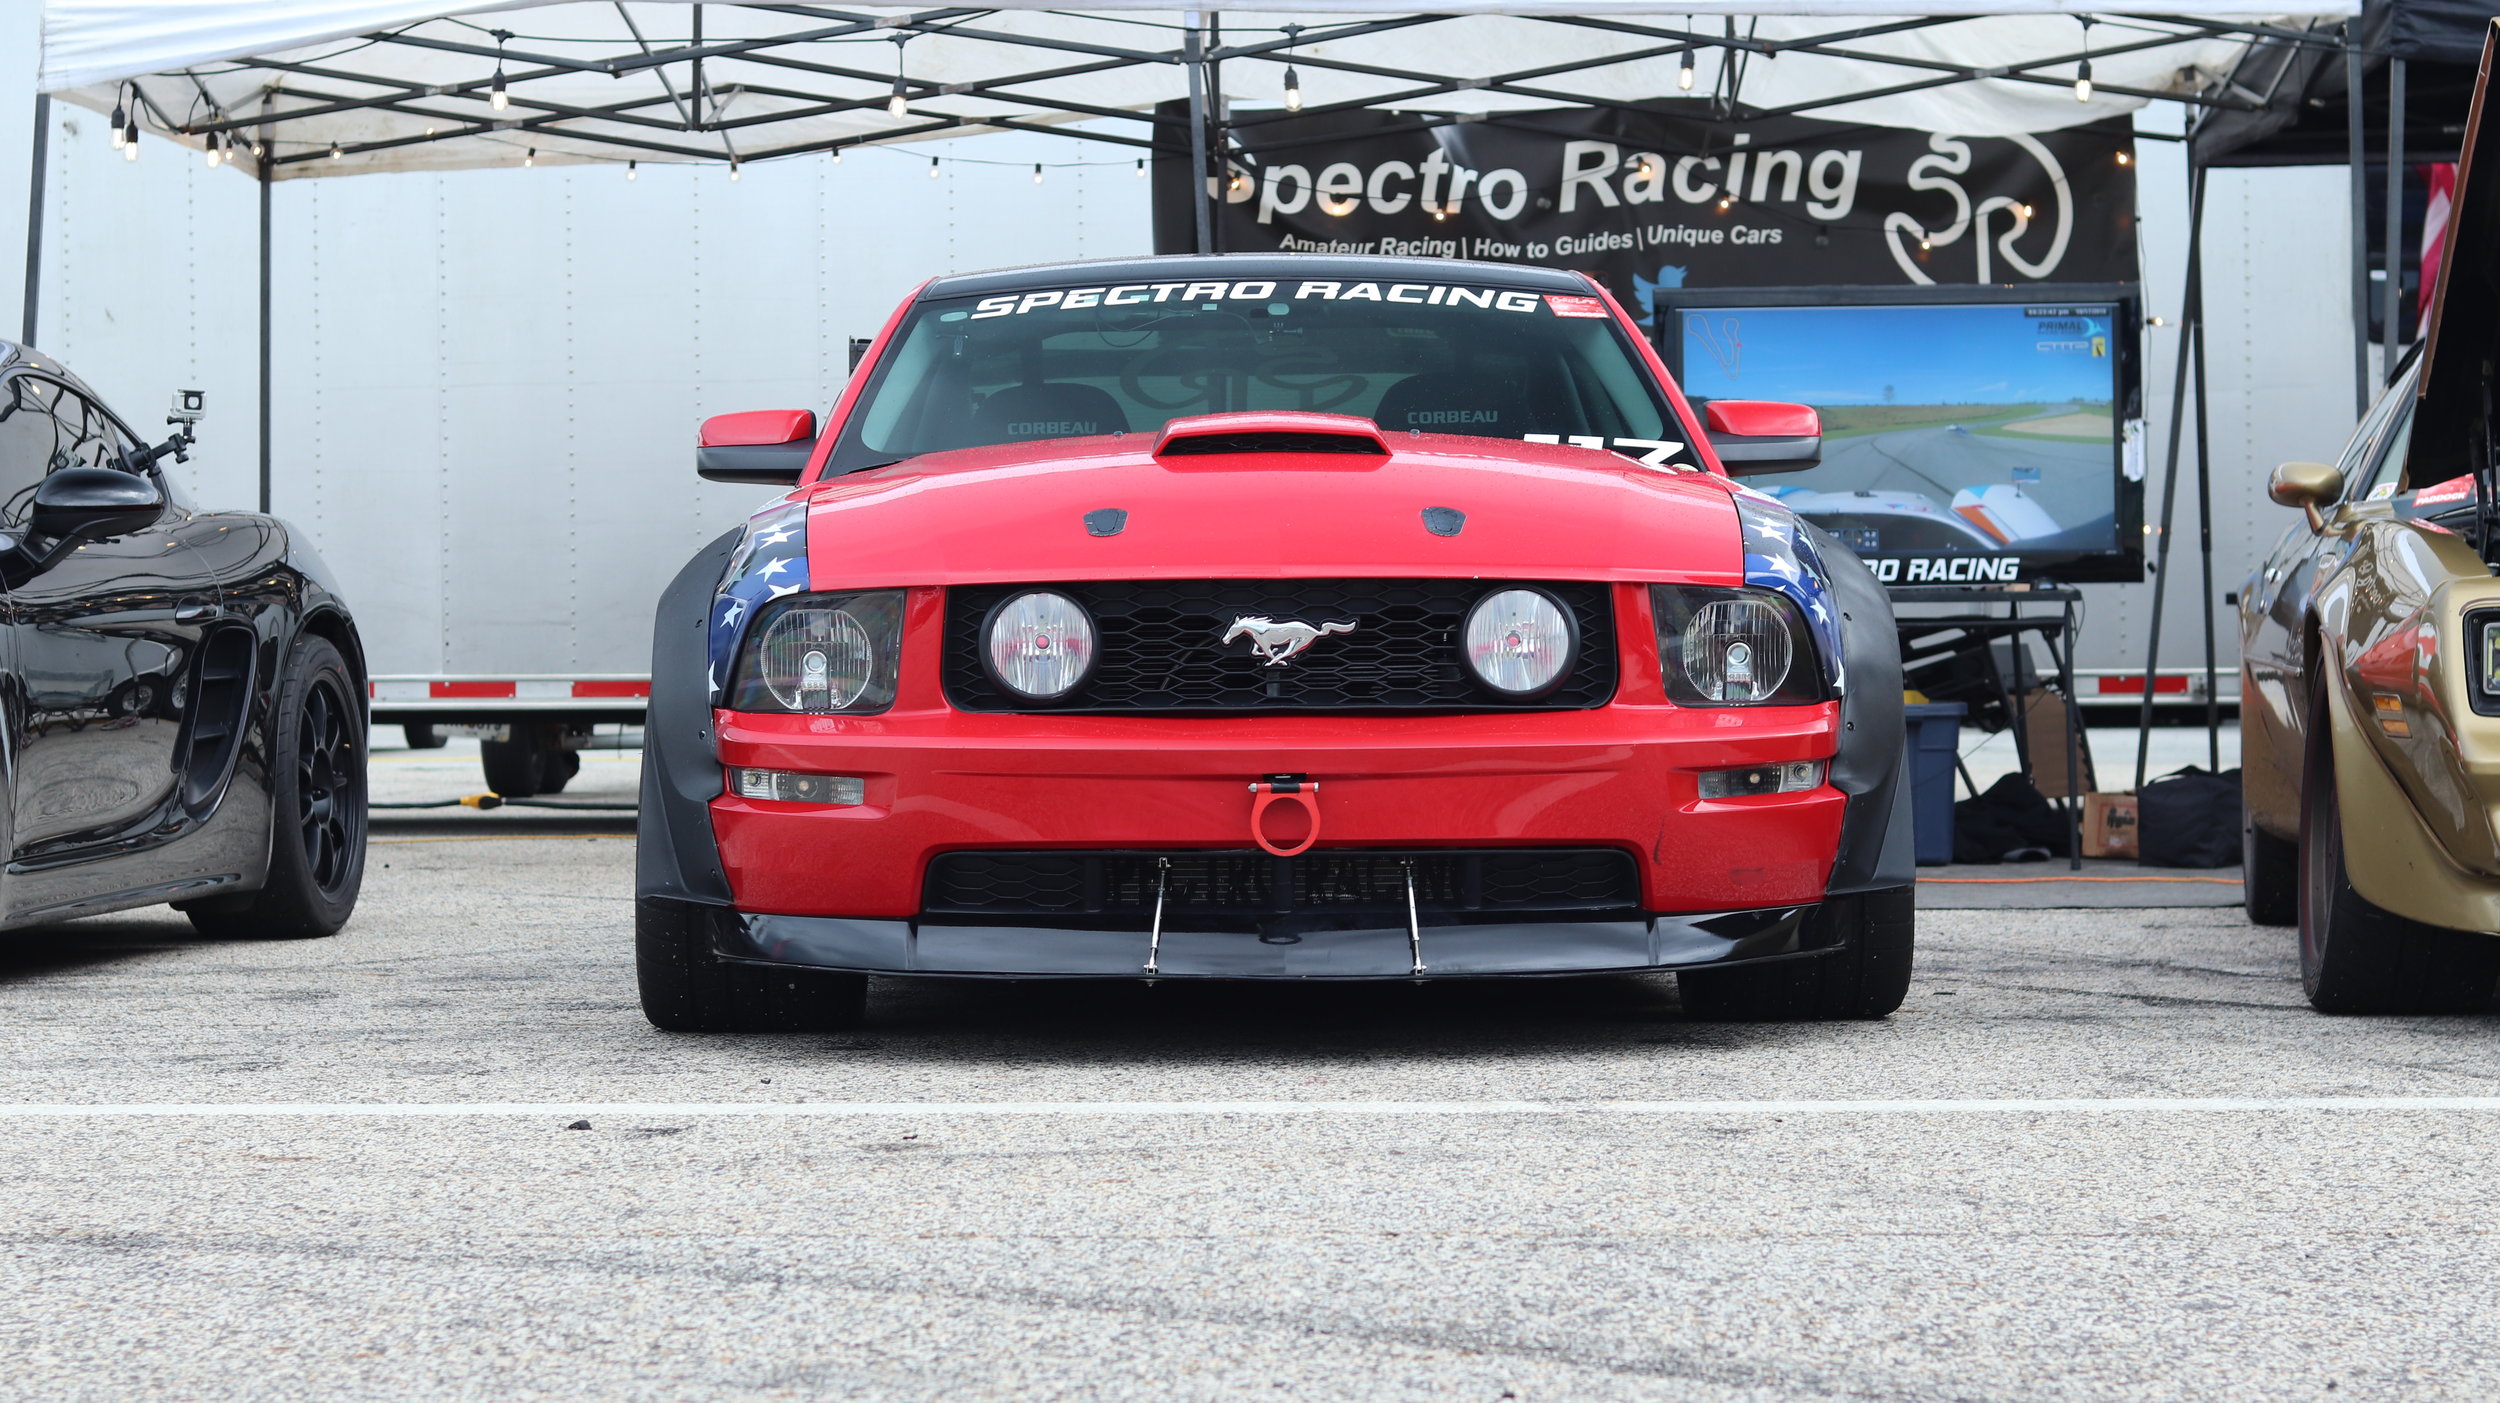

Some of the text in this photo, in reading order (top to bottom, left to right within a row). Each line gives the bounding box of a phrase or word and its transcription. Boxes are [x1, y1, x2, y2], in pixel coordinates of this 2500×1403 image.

[1559, 133, 1863, 220] Racing
[1279, 233, 1374, 254] Amateur
[1380, 236, 1456, 258] Racing
[1474, 238, 1521, 258] How
[1526, 240, 1549, 259] to
[1555, 231, 1634, 255] Guides
[1647, 224, 1724, 247] Unique
[1730, 225, 1783, 245] Cars
[970, 281, 1540, 320] SPECTRO RACING
[2038, 321, 2083, 331] PRIMAL
[1407, 410, 1498, 424] CORBEAU
[1007, 421, 1097, 435] CORBEAU
[2415, 492, 2467, 505] PADDOCK
[1907, 557, 2020, 582] RACING
